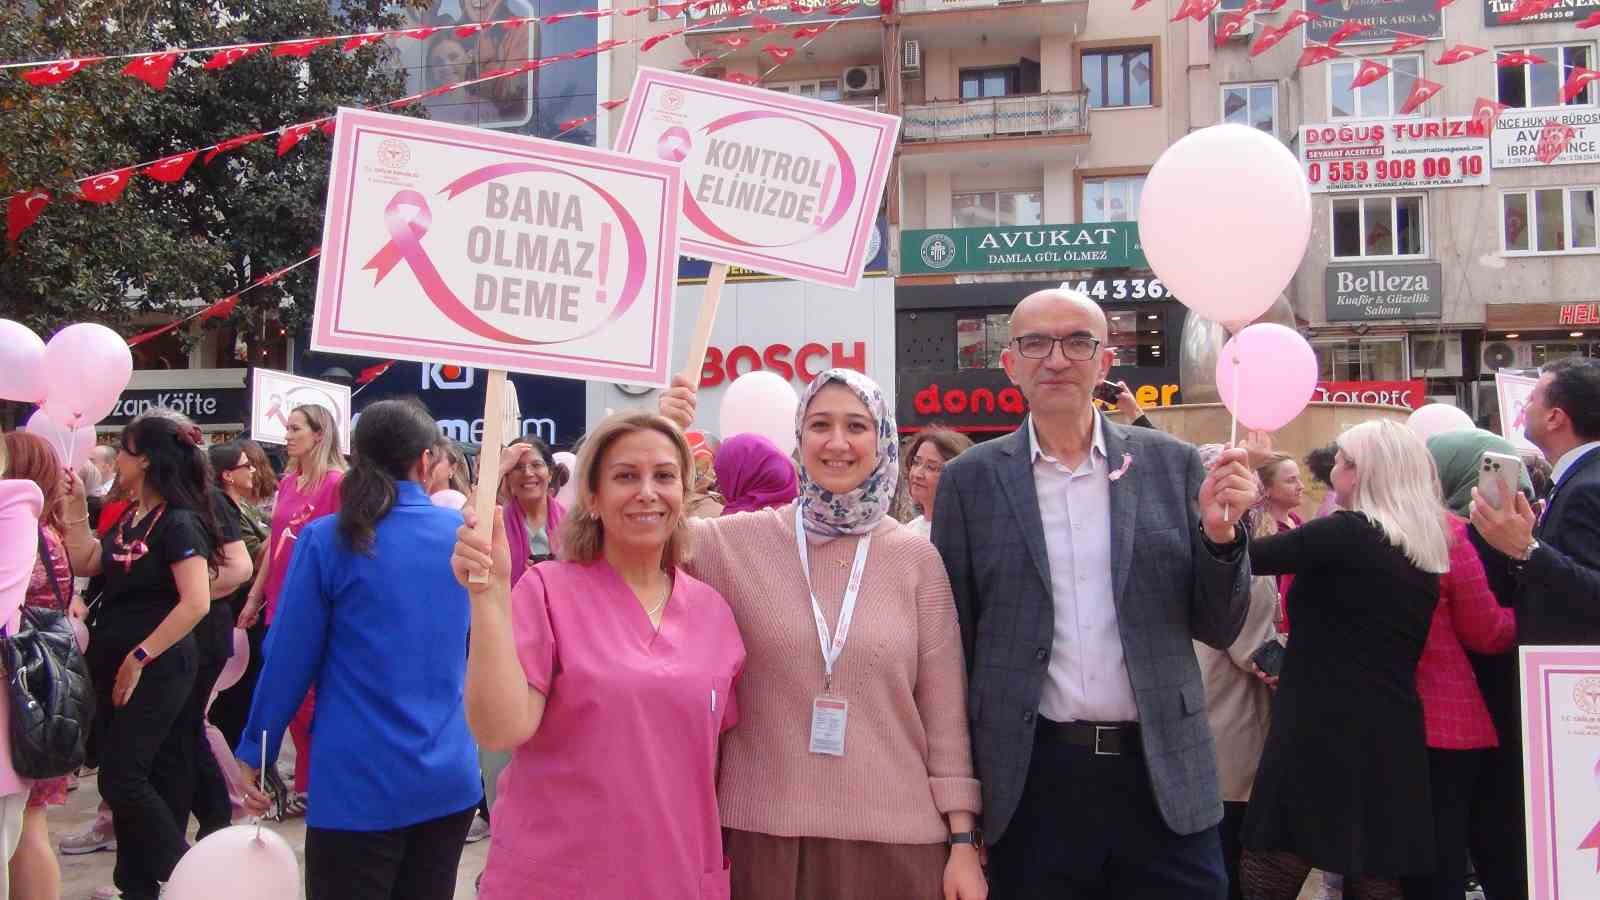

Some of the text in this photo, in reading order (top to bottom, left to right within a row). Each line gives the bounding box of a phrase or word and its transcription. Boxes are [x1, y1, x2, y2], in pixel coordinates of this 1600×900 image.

[1562, 112, 1600, 125] BÜROS
[1306, 123, 1384, 145] DOĞUŞ
[705, 138, 821, 188] KONTROL
[1309, 155, 1482, 183] 0 553 908 00 10
[485, 182, 583, 232] BANA
[697, 172, 816, 224] ELİNİZDE
[977, 228, 1117, 249] AVUKAT
[466, 225, 595, 278] OLMAZ
[989, 250, 1108, 264] DAMLA GÜL ÖLMEZ
[1336, 270, 1430, 293] Belleza
[473, 273, 581, 322] DEME
[1336, 294, 1375, 307] Kuaför
[1387, 293, 1431, 304] Güzellik
[1364, 305, 1401, 316] Salonu
[1560, 304, 1600, 325] HEL
[698, 341, 866, 388] BOSCH
[157, 392, 217, 416] Köfte
[914, 384, 1025, 415] dona
